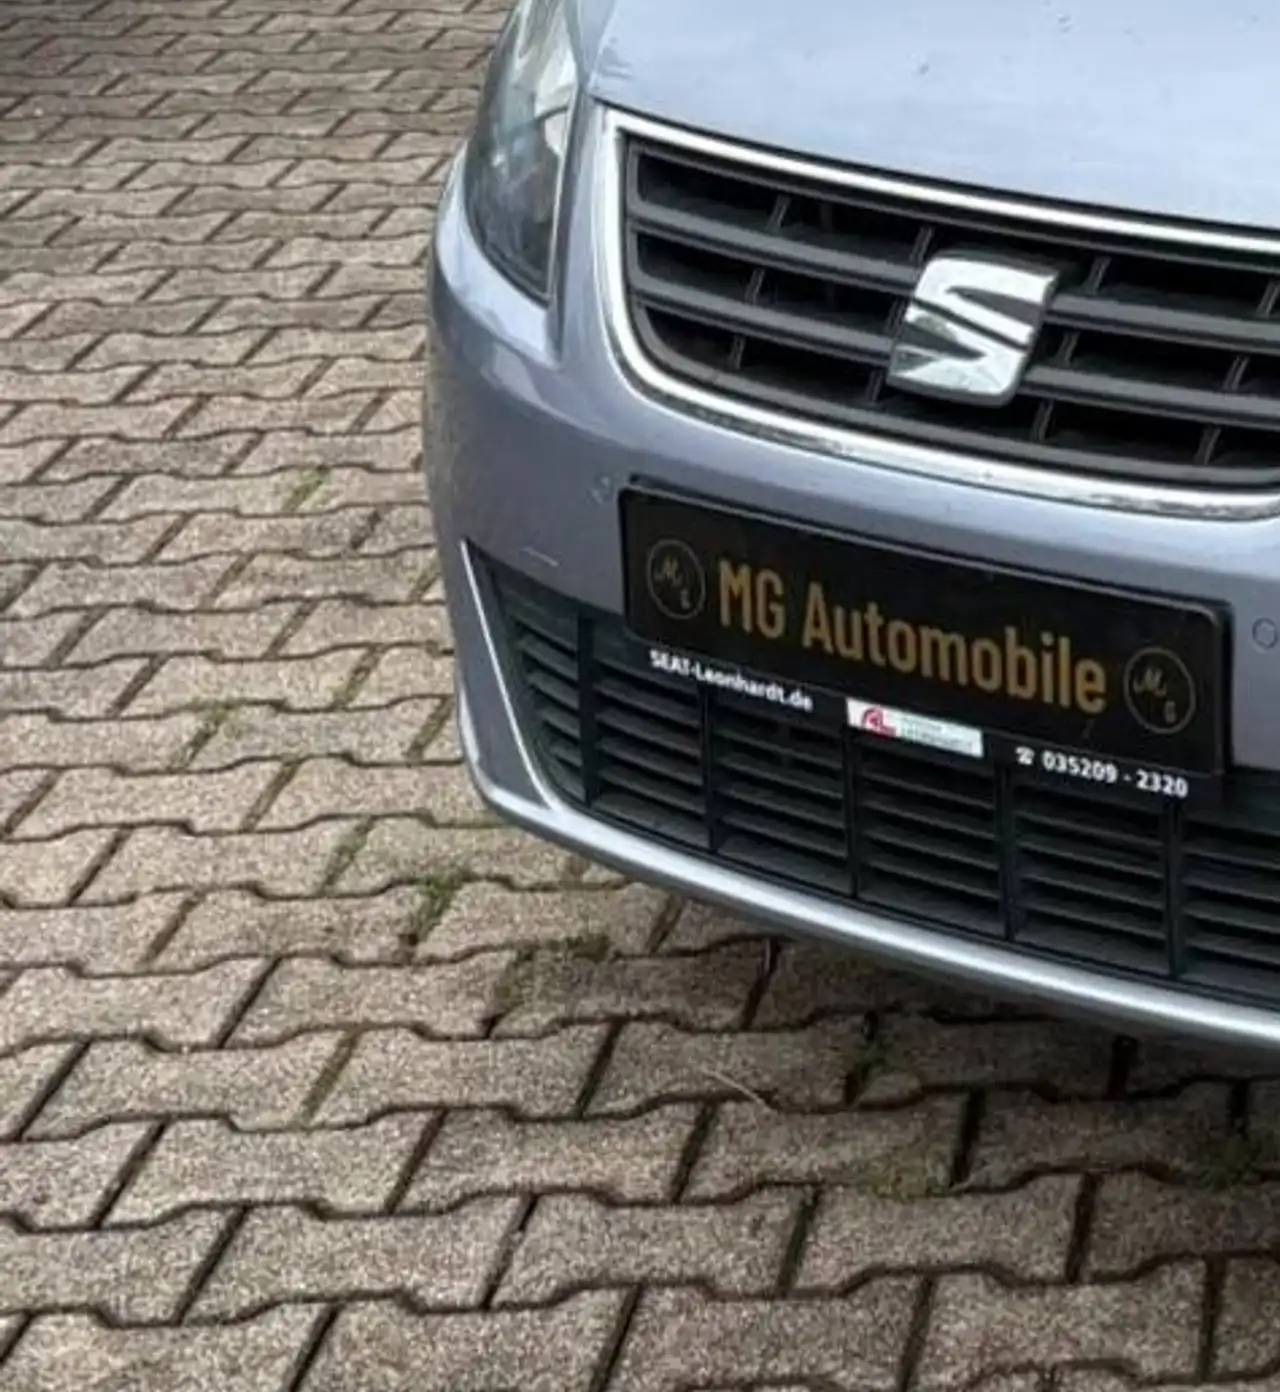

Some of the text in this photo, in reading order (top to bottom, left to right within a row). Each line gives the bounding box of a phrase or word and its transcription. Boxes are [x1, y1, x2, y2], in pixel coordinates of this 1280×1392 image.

[719, 559, 1107, 715] MG Automobile
[650, 649, 813, 713] SEAT-Leonhardt.de
[1042, 749, 1119, 784] 035209
[1136, 768, 1189, 798] 2320
